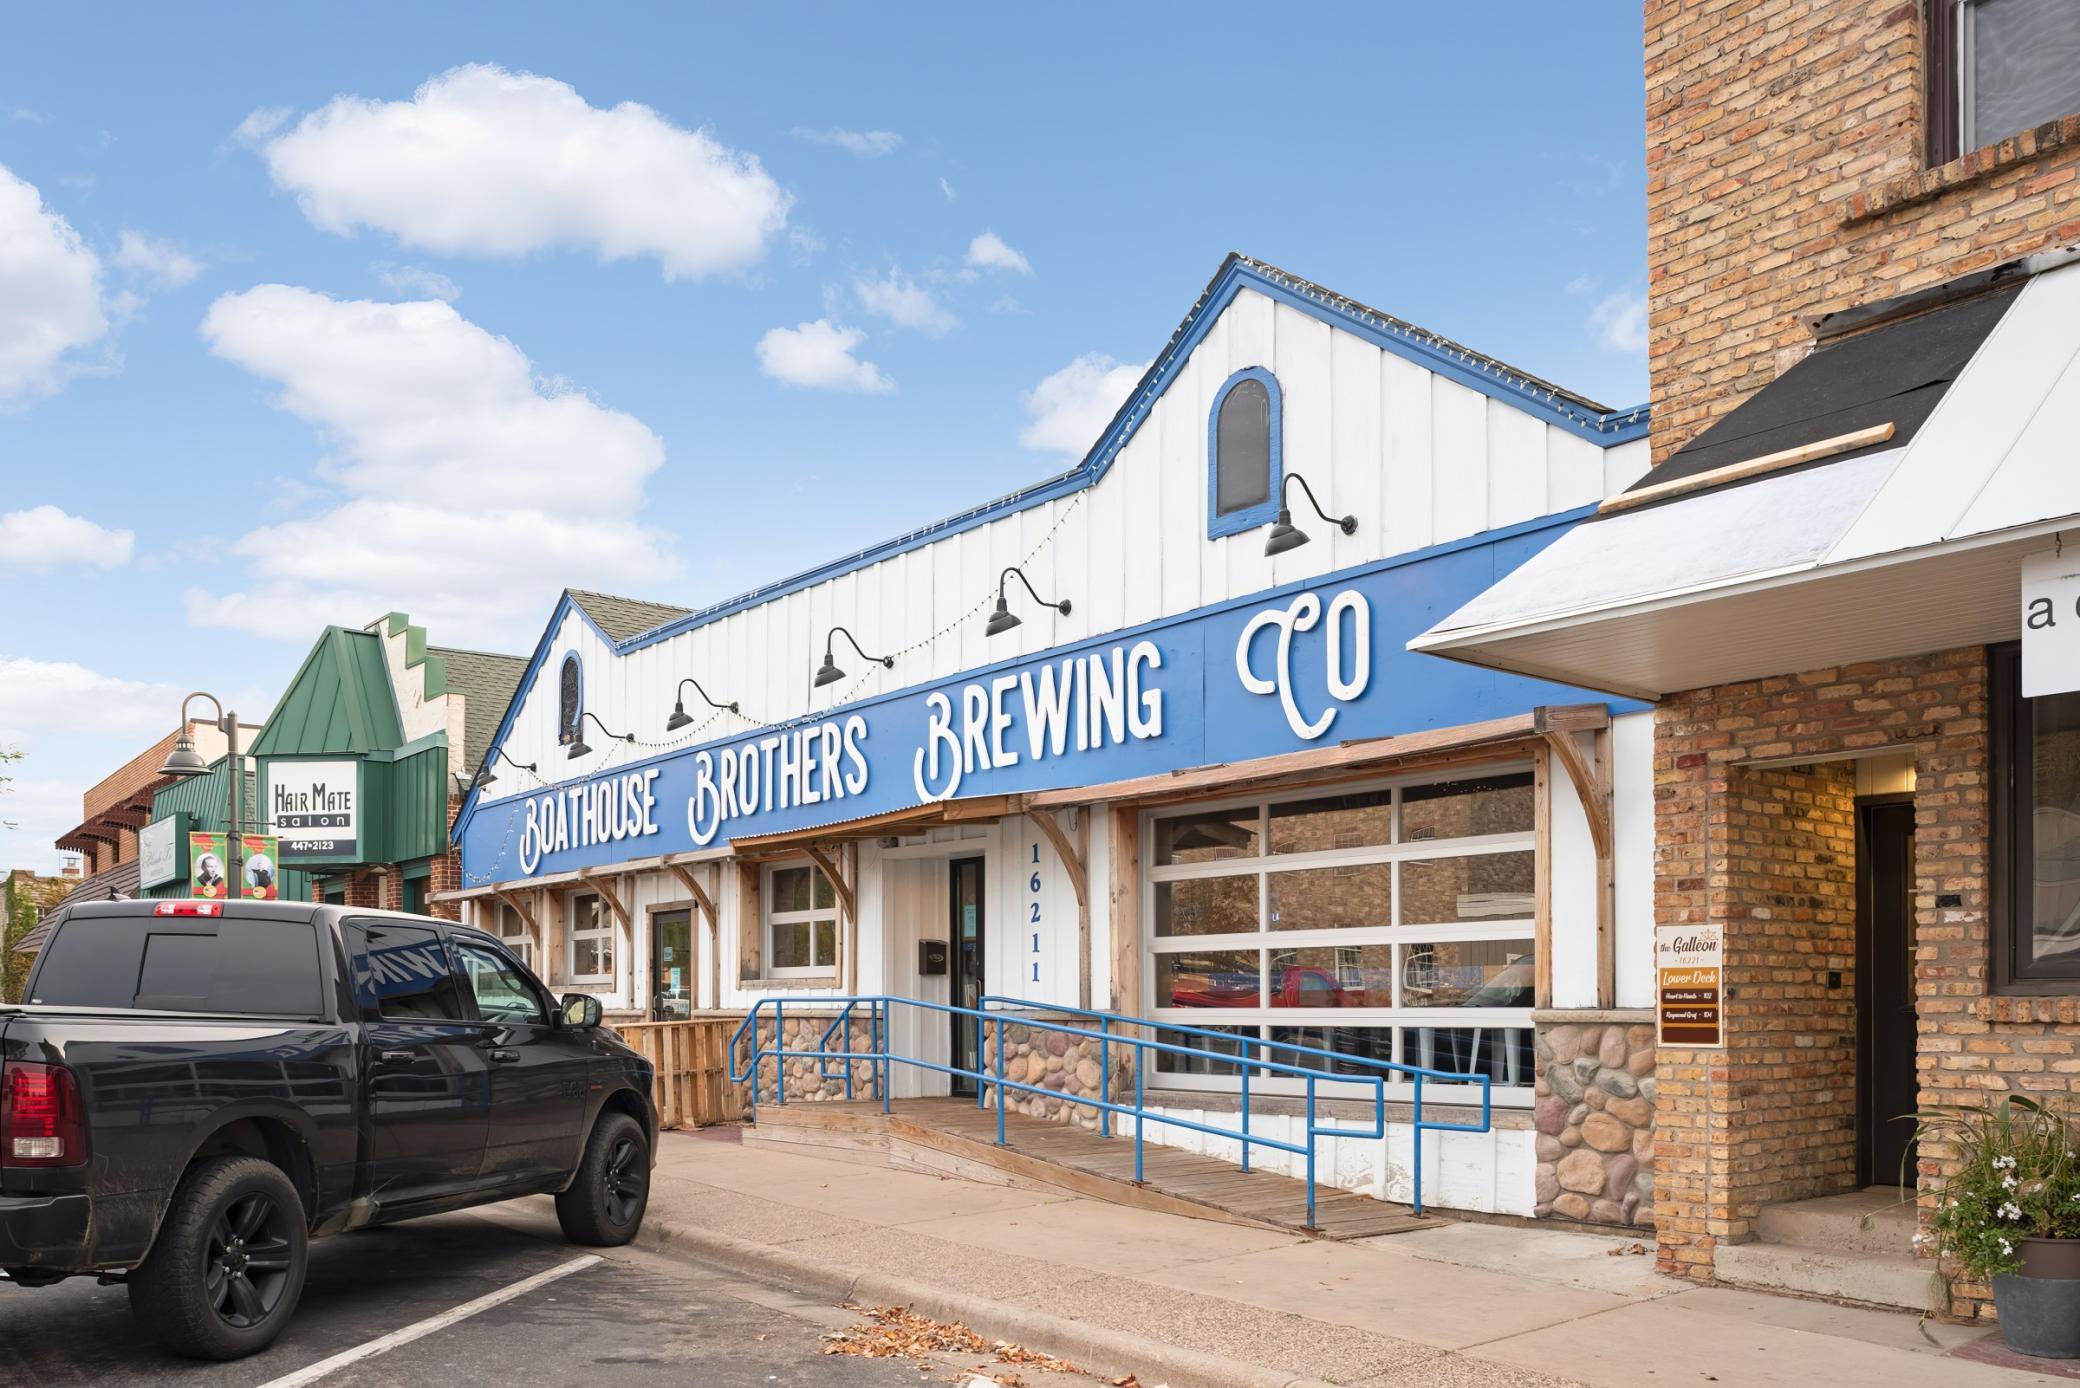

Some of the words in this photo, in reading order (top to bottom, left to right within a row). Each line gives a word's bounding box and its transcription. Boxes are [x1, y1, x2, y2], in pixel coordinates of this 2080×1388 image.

[519, 768, 661, 875] BOATHOUSE
[687, 715, 869, 846] BROTHERS
[913, 640, 1163, 804] BREWING
[1235, 589, 1371, 740] CO
[274, 783, 309, 814] HAIR
[312, 782, 352, 812] MATE
[280, 815, 345, 827] salon
[1660, 943, 1671, 952] the
[1673, 936, 1718, 954] Galleon
[1663, 971, 1691, 985] Lower
[1693, 970, 1716, 984] Deck
